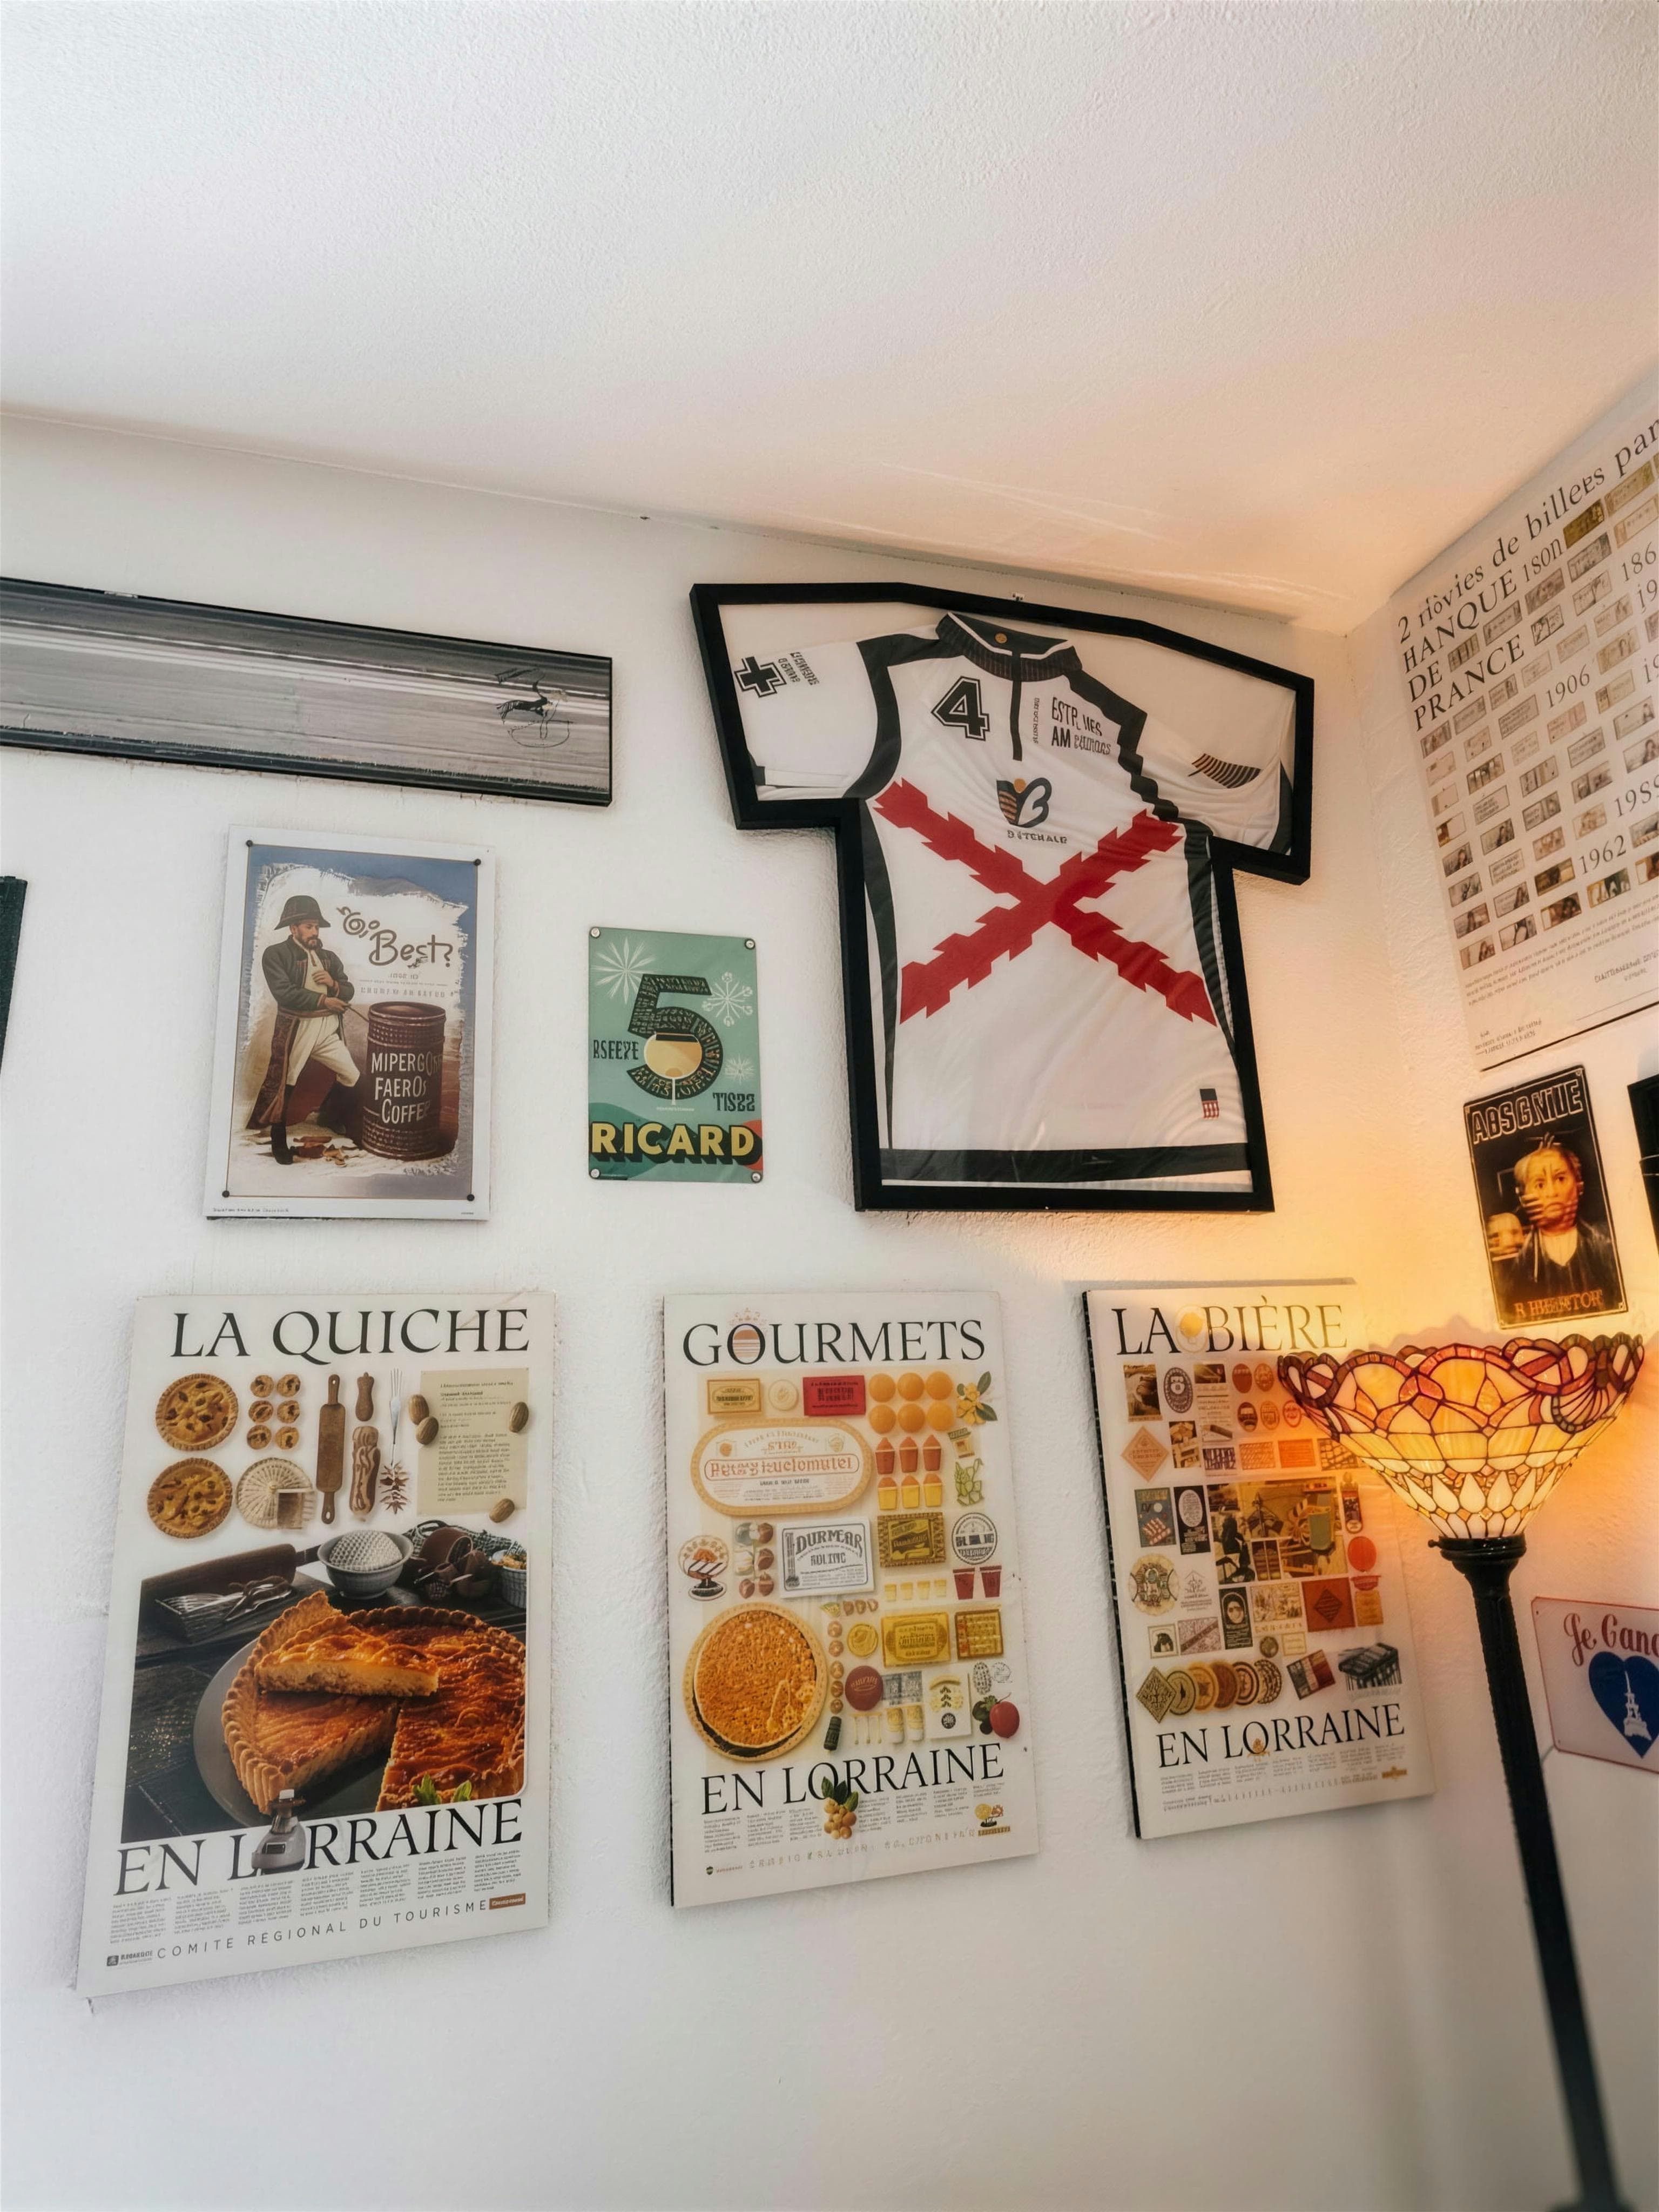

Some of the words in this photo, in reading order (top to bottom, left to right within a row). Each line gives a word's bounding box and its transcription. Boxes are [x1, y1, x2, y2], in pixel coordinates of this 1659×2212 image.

[1492, 536, 1520, 568] de
[1407, 660, 1443, 703] DE
[1547, 664, 1590, 708] 1906
[931, 676, 990, 740] 4
[1579, 835, 1627, 874] 1962
[591, 1121, 757, 1161] RICARD
[170, 1312, 250, 1358] LA
[272, 1308, 529, 1365] QUICHE
[683, 1319, 986, 1366] GOURMETS
[1111, 1307, 1182, 1355] LA
[1200, 1294, 1347, 1353] BIÈRE
[1156, 1728, 1210, 1768] EN
[1220, 1702, 1405, 1759] LORRAINE
[702, 1770, 765, 1815] EN
[782, 1742, 1004, 1804] LORRAINE
[113, 1838, 207, 1897] EN
[226, 1798, 522, 1880] LRRAINE
[360, 1915, 381, 1929] DU
[394, 1899, 487, 1924] TOURISME
